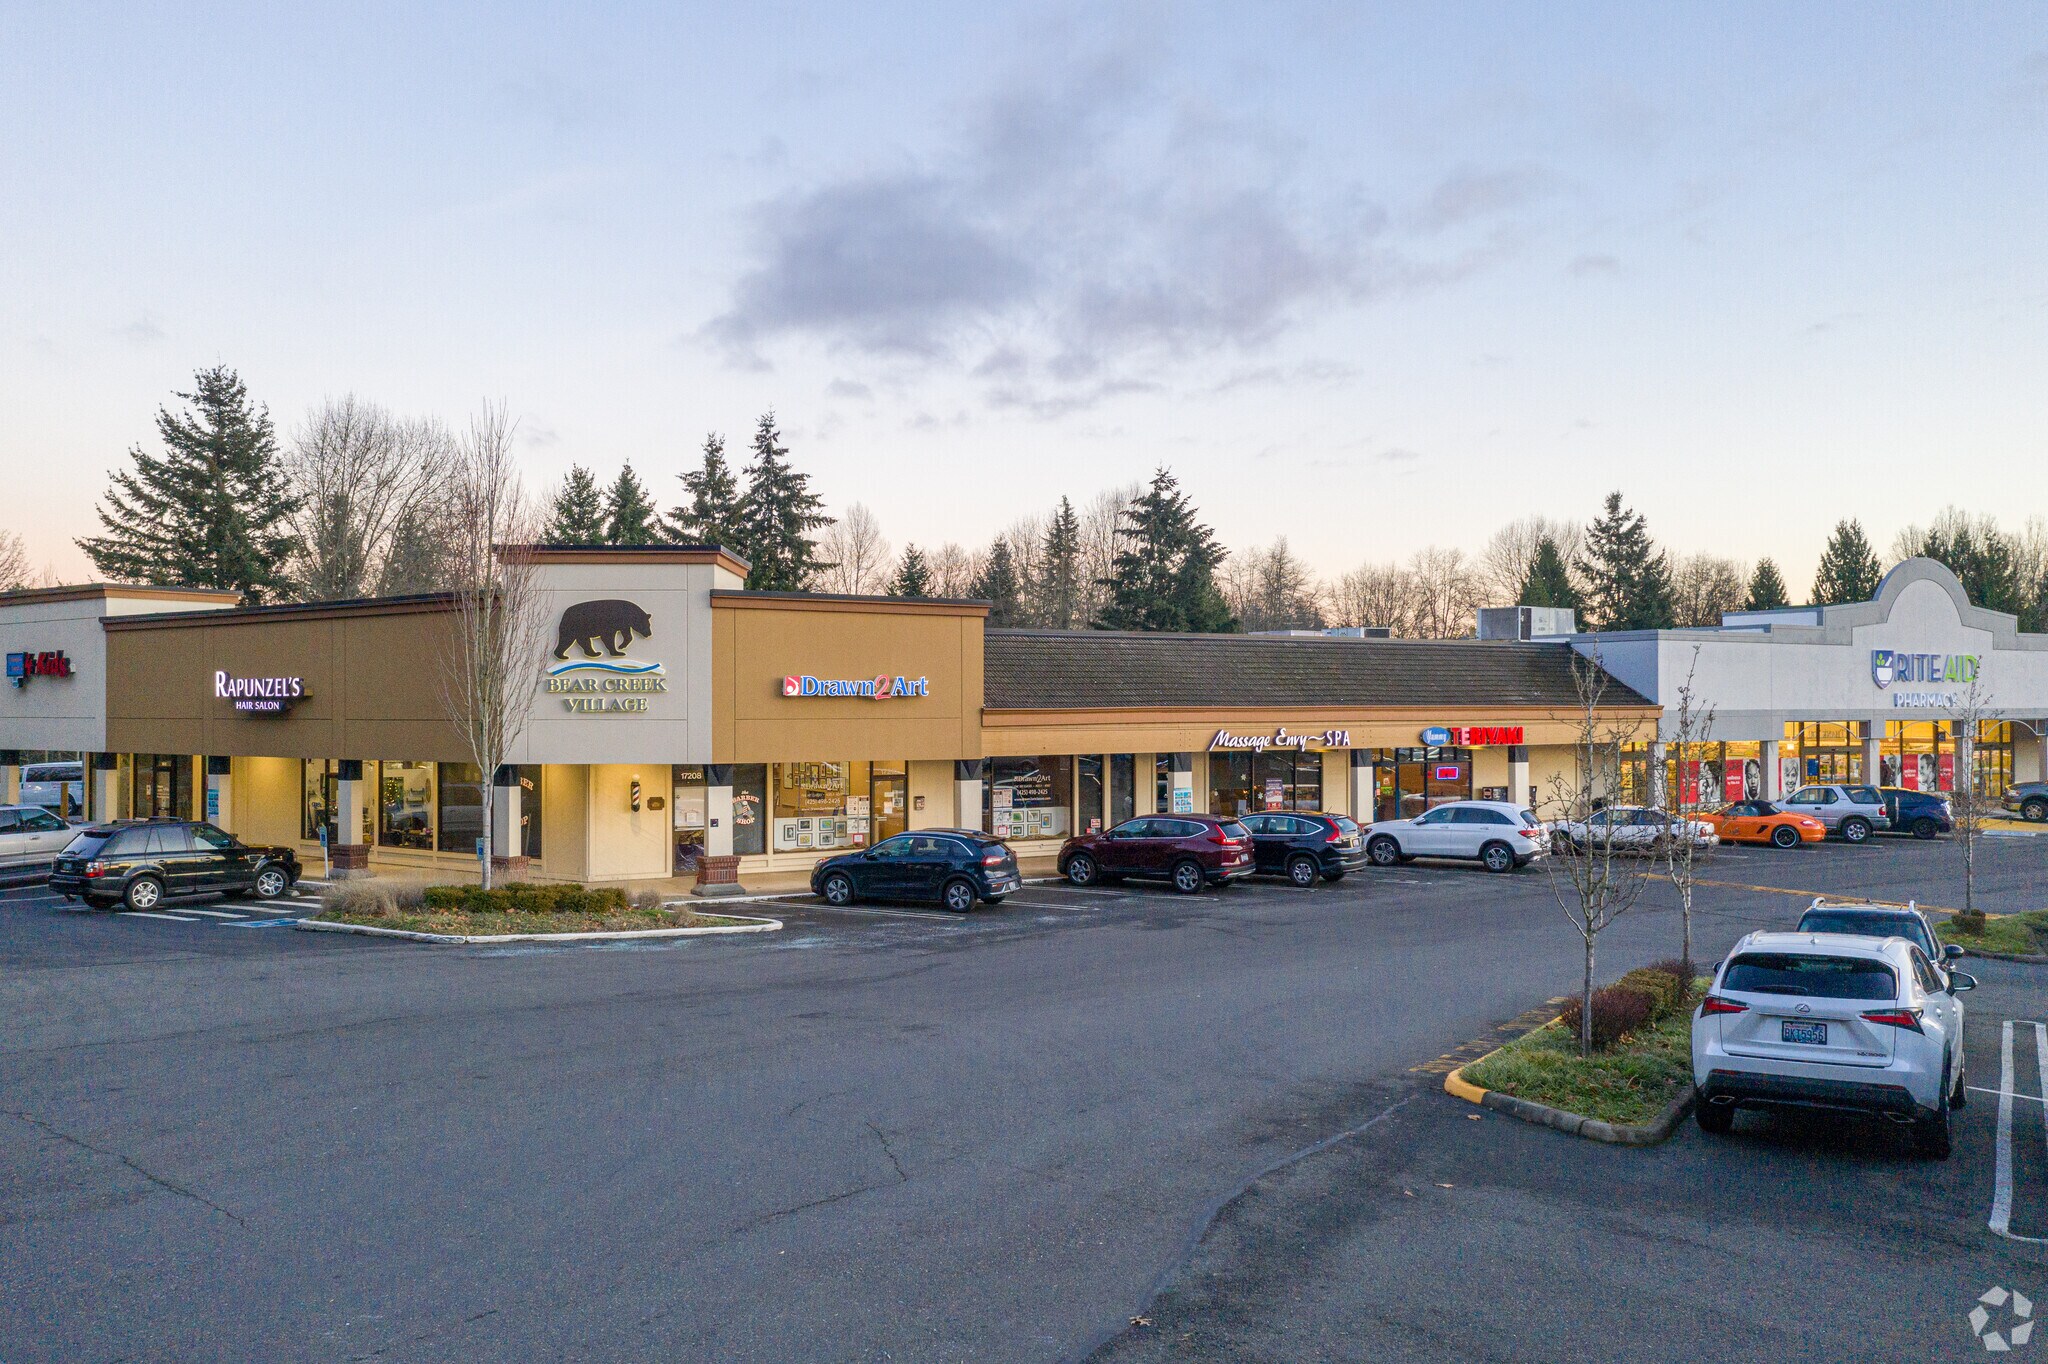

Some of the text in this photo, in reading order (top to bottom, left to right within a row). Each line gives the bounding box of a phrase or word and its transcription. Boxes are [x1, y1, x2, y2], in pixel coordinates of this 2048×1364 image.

[37, 652, 68, 677] Kids
[215, 670, 300, 697] RAPUNZEL'S
[546, 678, 668, 693] BEAR CREEK
[800, 674, 929, 700] Drawn2Art
[236, 701, 280, 709] HAIR SALON
[563, 697, 650, 713] VILLAGE
[1894, 693, 1957, 707] PHARMACY
[1208, 729, 1270, 752] Massage
[1425, 726, 1524, 745] Yummy TERIYAKI
